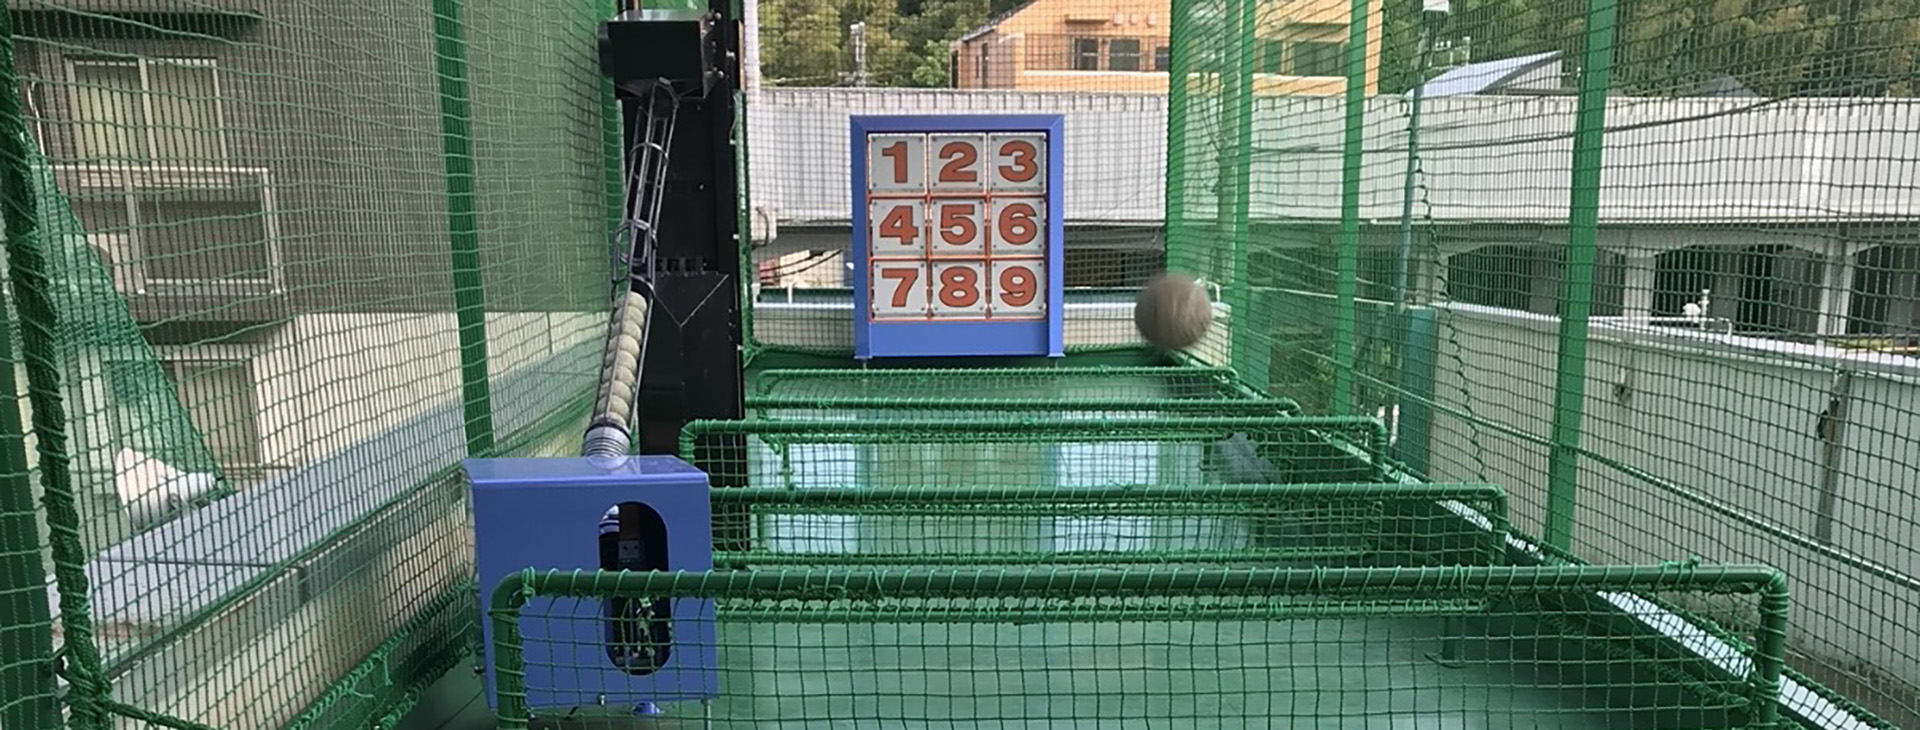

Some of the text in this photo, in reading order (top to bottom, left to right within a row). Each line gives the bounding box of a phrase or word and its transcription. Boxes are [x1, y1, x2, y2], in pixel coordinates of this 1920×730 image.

[881, 140, 1038, 183] 1 2 3
[879, 202, 1038, 245] 4 5 6
[881, 266, 1037, 307] 7 8 9
